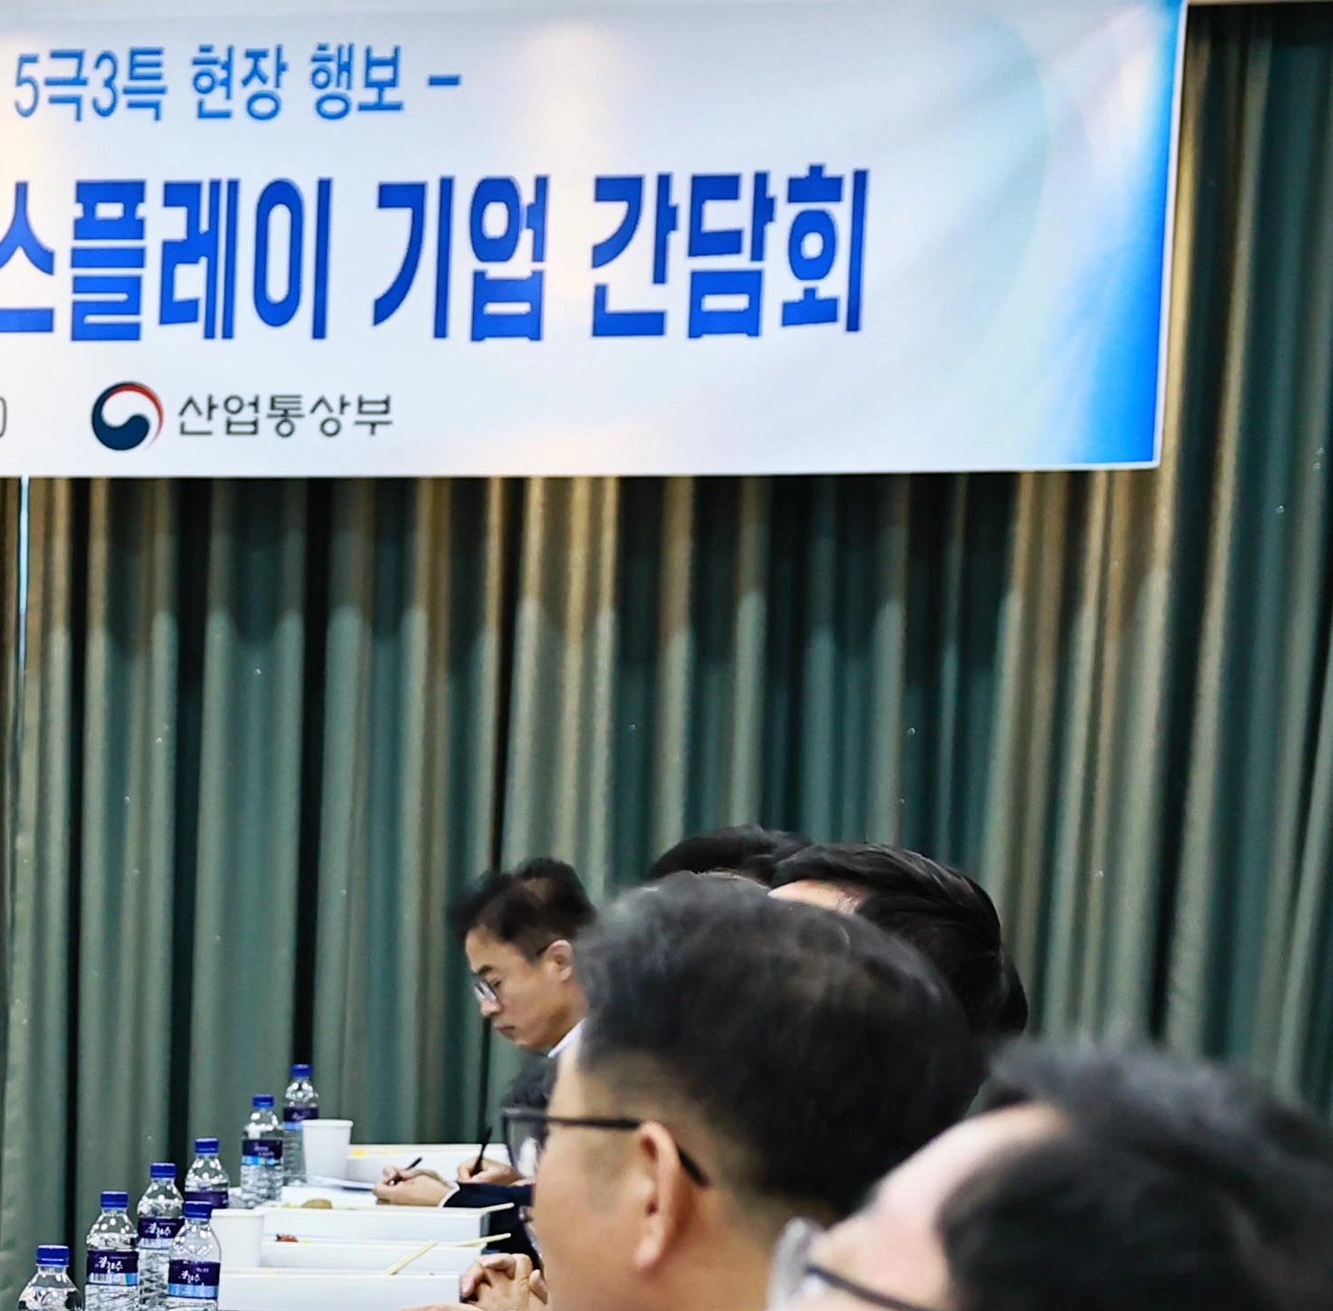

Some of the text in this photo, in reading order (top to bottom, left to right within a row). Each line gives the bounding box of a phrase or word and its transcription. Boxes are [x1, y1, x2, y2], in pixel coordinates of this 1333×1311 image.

[13, 46, 168, 123] 5극3특
[191, 43, 289, 121] 현장
[309, 41, 405, 121] 행보
[372, 174, 550, 343] 기업
[591, 163, 870, 341] 간담회
[177, 393, 394, 439] 산업통상부
